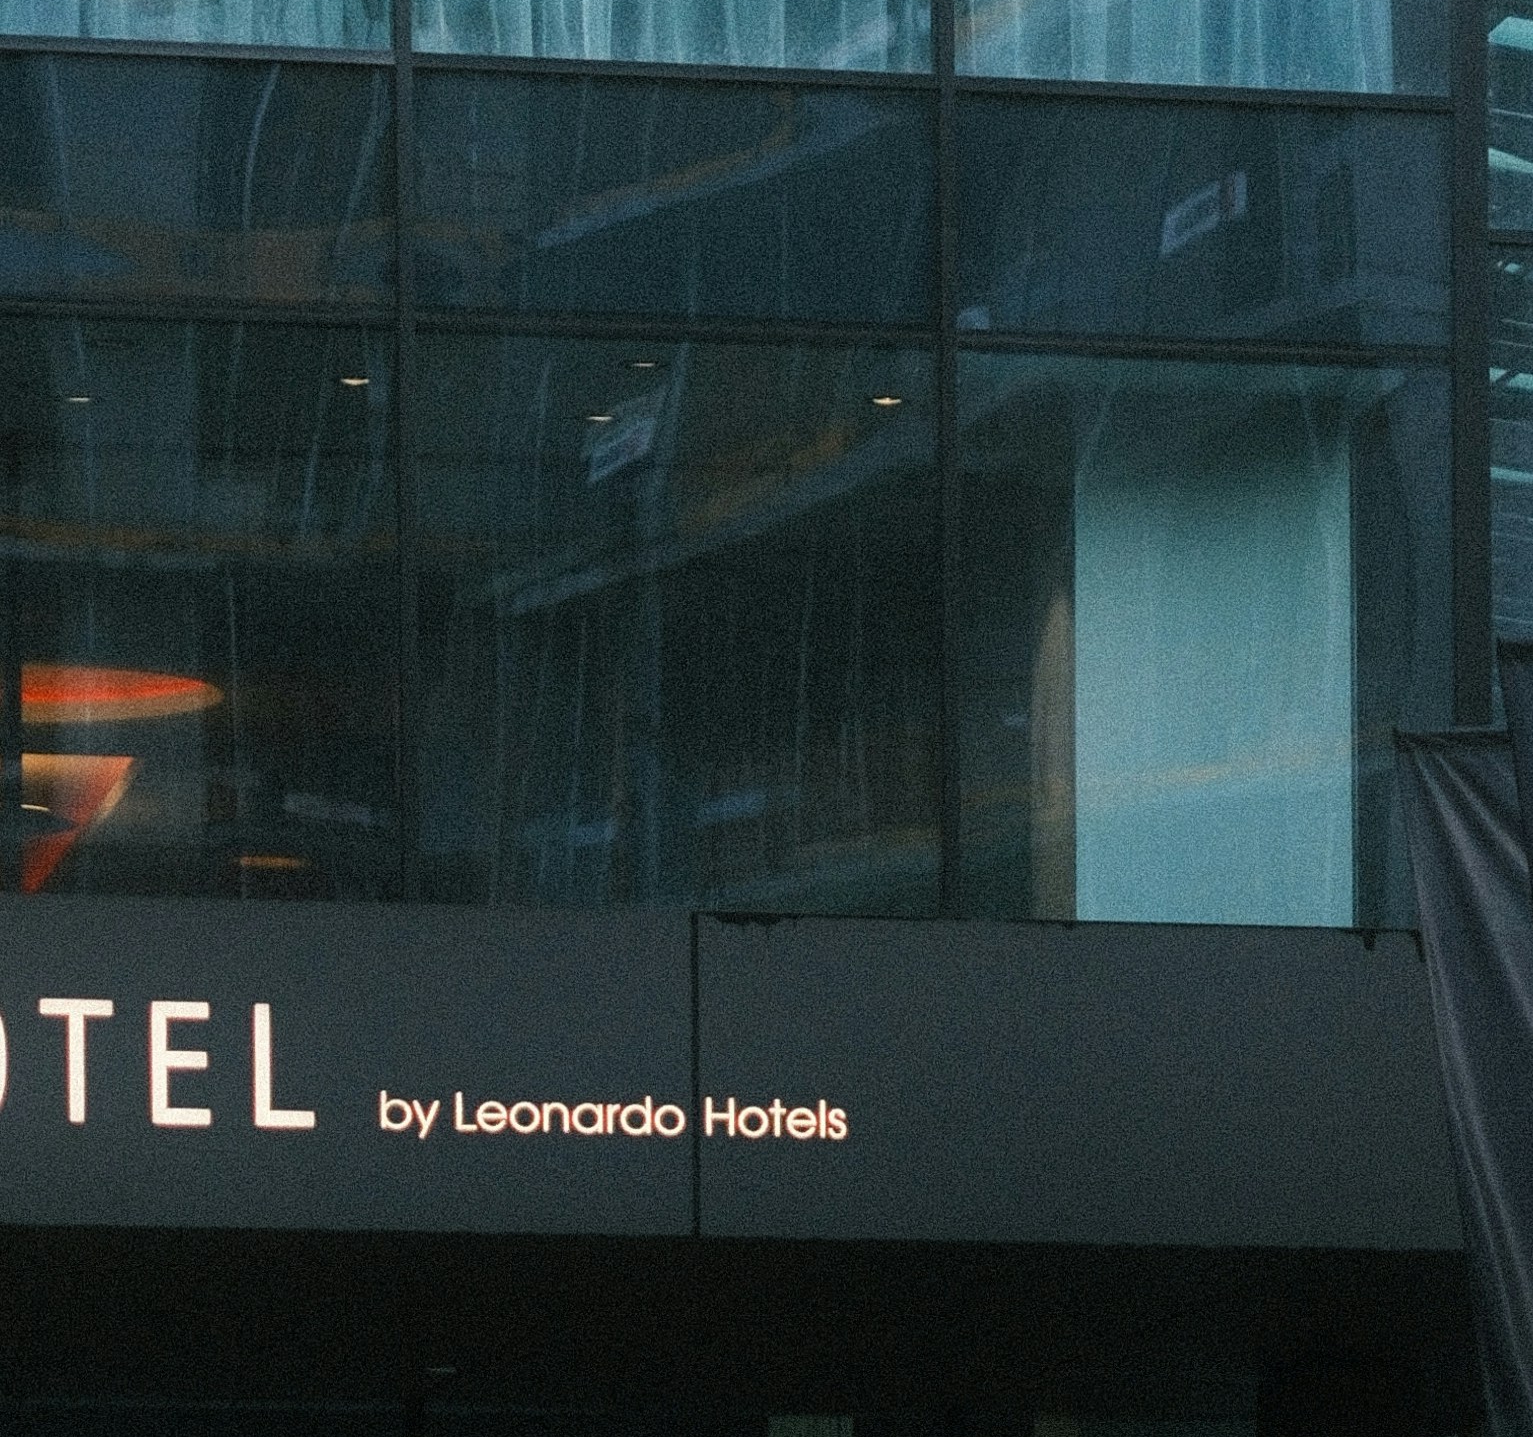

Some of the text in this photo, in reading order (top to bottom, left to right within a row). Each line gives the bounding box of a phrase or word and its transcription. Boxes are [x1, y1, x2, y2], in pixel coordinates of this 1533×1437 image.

[0, 996, 317, 1130] TEL
[378, 1090, 849, 1141] by Leonardo Hotels
